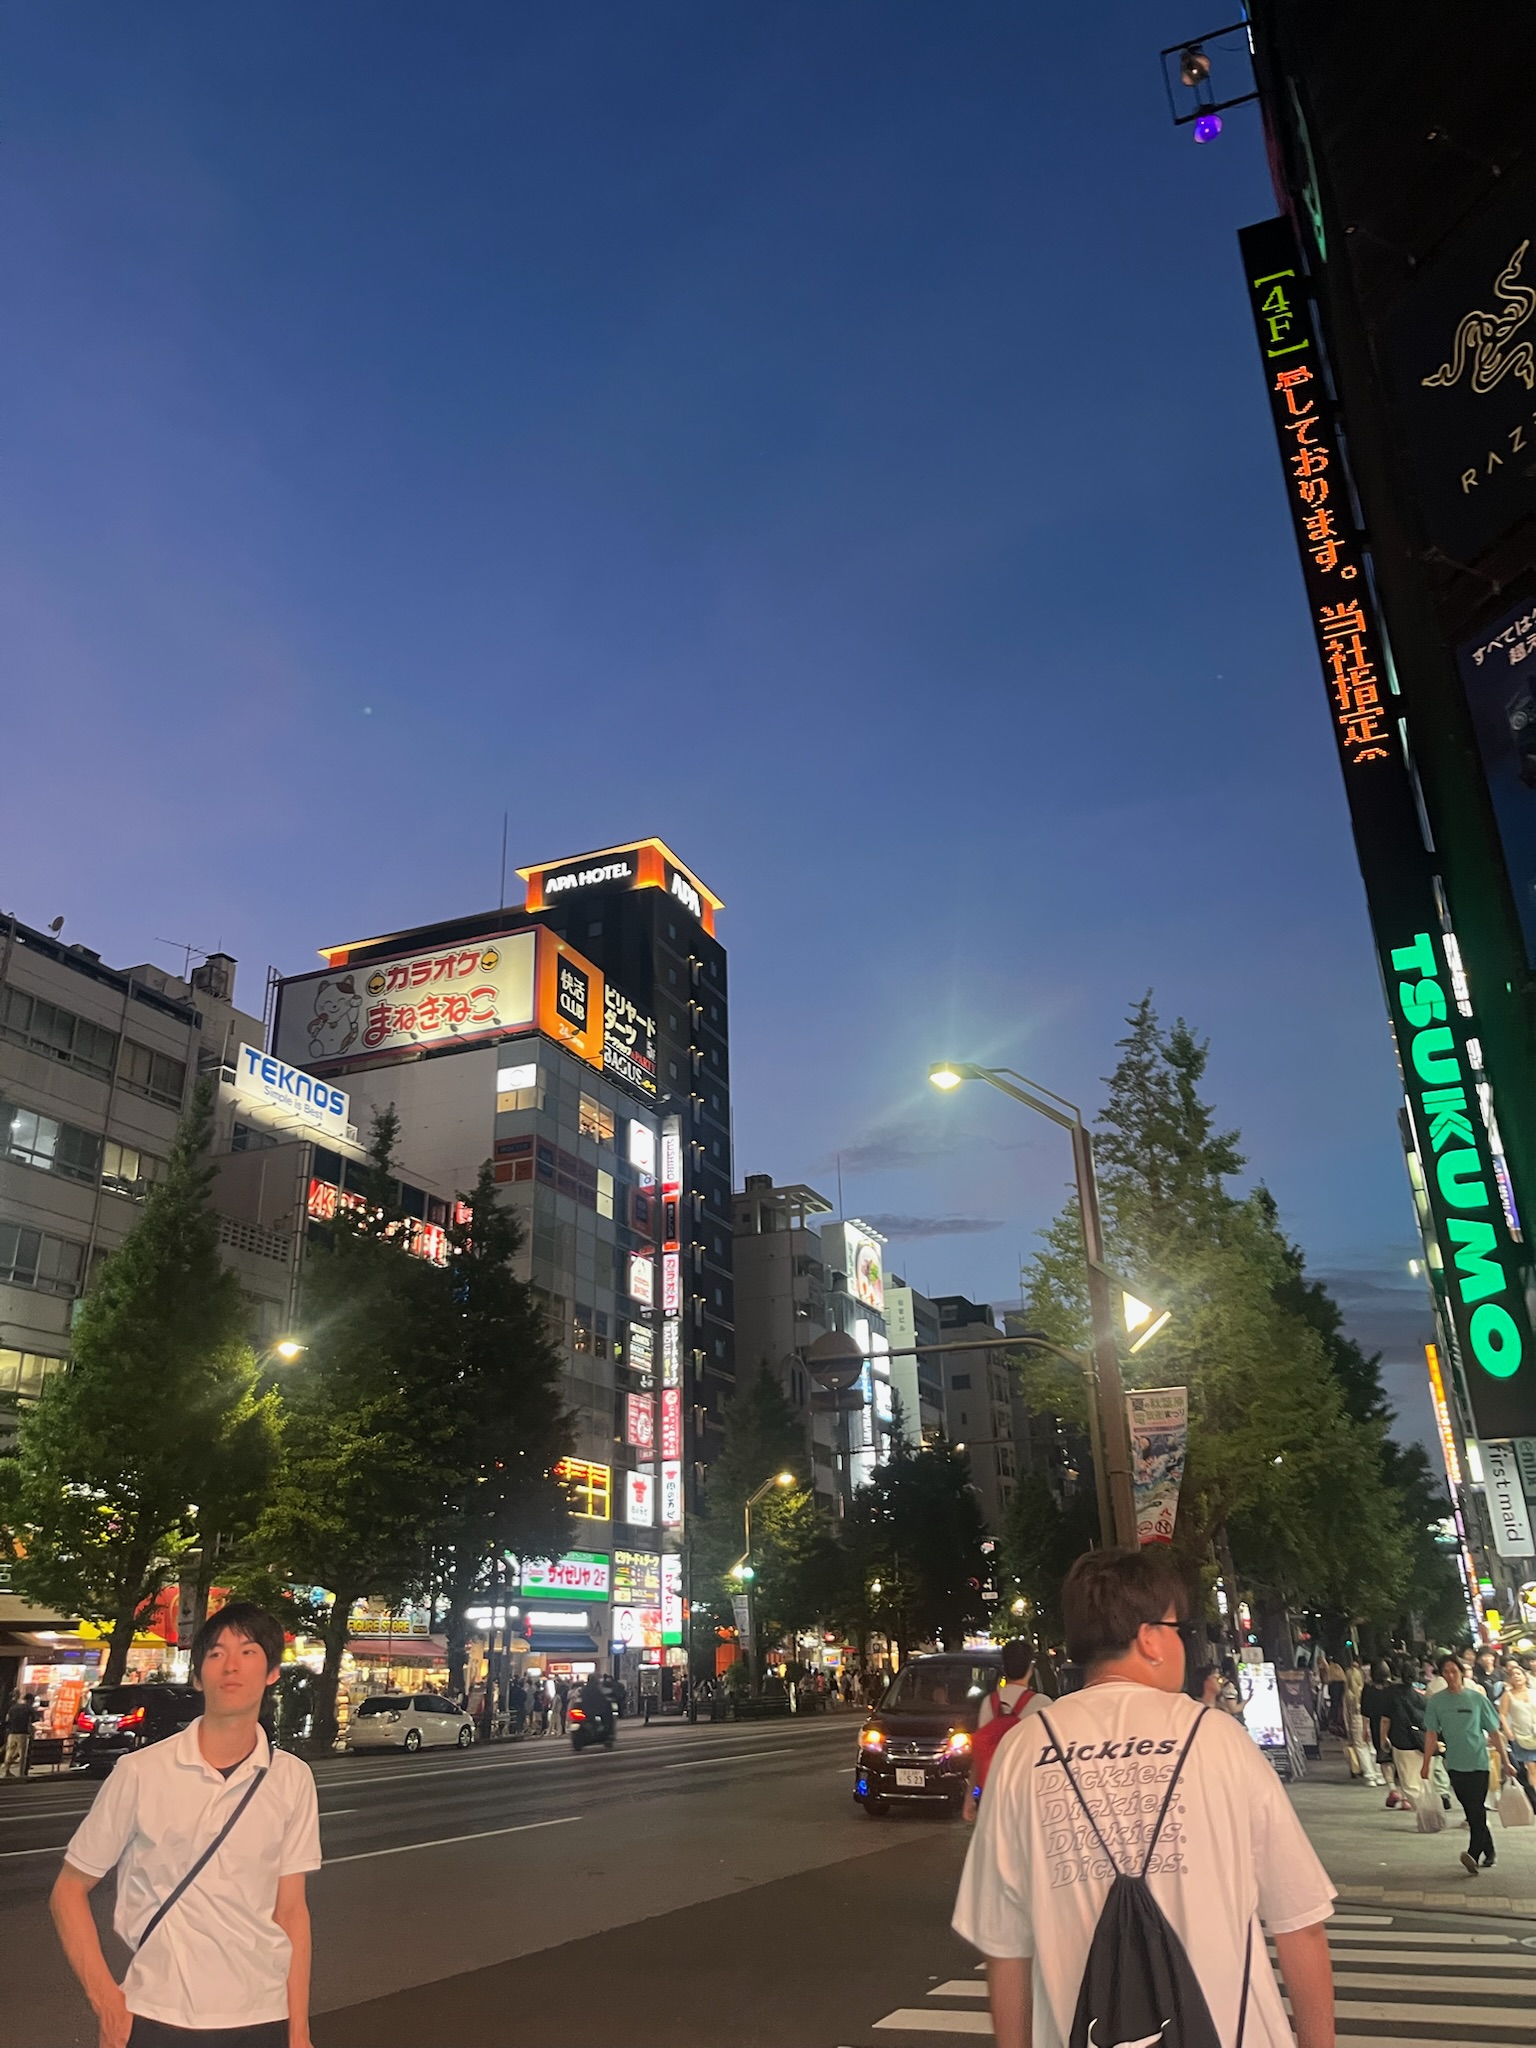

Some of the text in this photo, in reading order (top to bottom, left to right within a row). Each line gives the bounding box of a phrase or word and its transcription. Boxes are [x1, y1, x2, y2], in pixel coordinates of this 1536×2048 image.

[1461, 411, 1536, 494] RAZ
[545, 861, 632, 894] APA HOTEL
[671, 872, 702, 918] APA
[385, 950, 481, 992] カラオケ
[560, 968, 585, 1003] 快活
[363, 986, 498, 1047] まねきねこ
[559, 993, 586, 1021] CLUB
[603, 1008, 637, 1045] ダーツ
[604, 983, 657, 1038] ビリヤード
[245, 1047, 345, 1116] TEKNOS
[604, 1045, 643, 1086] BAGUS
[263, 1085, 323, 1120] Simple is Best
[666, 1138, 676, 1181] SUSHIRO
[1390, 932, 1523, 1379] TSUKUMO
[666, 1259, 676, 1304] カラオケ
[1498, 1486, 1525, 1542] maid
[547, 1564, 591, 1587] サイゼリヤ
